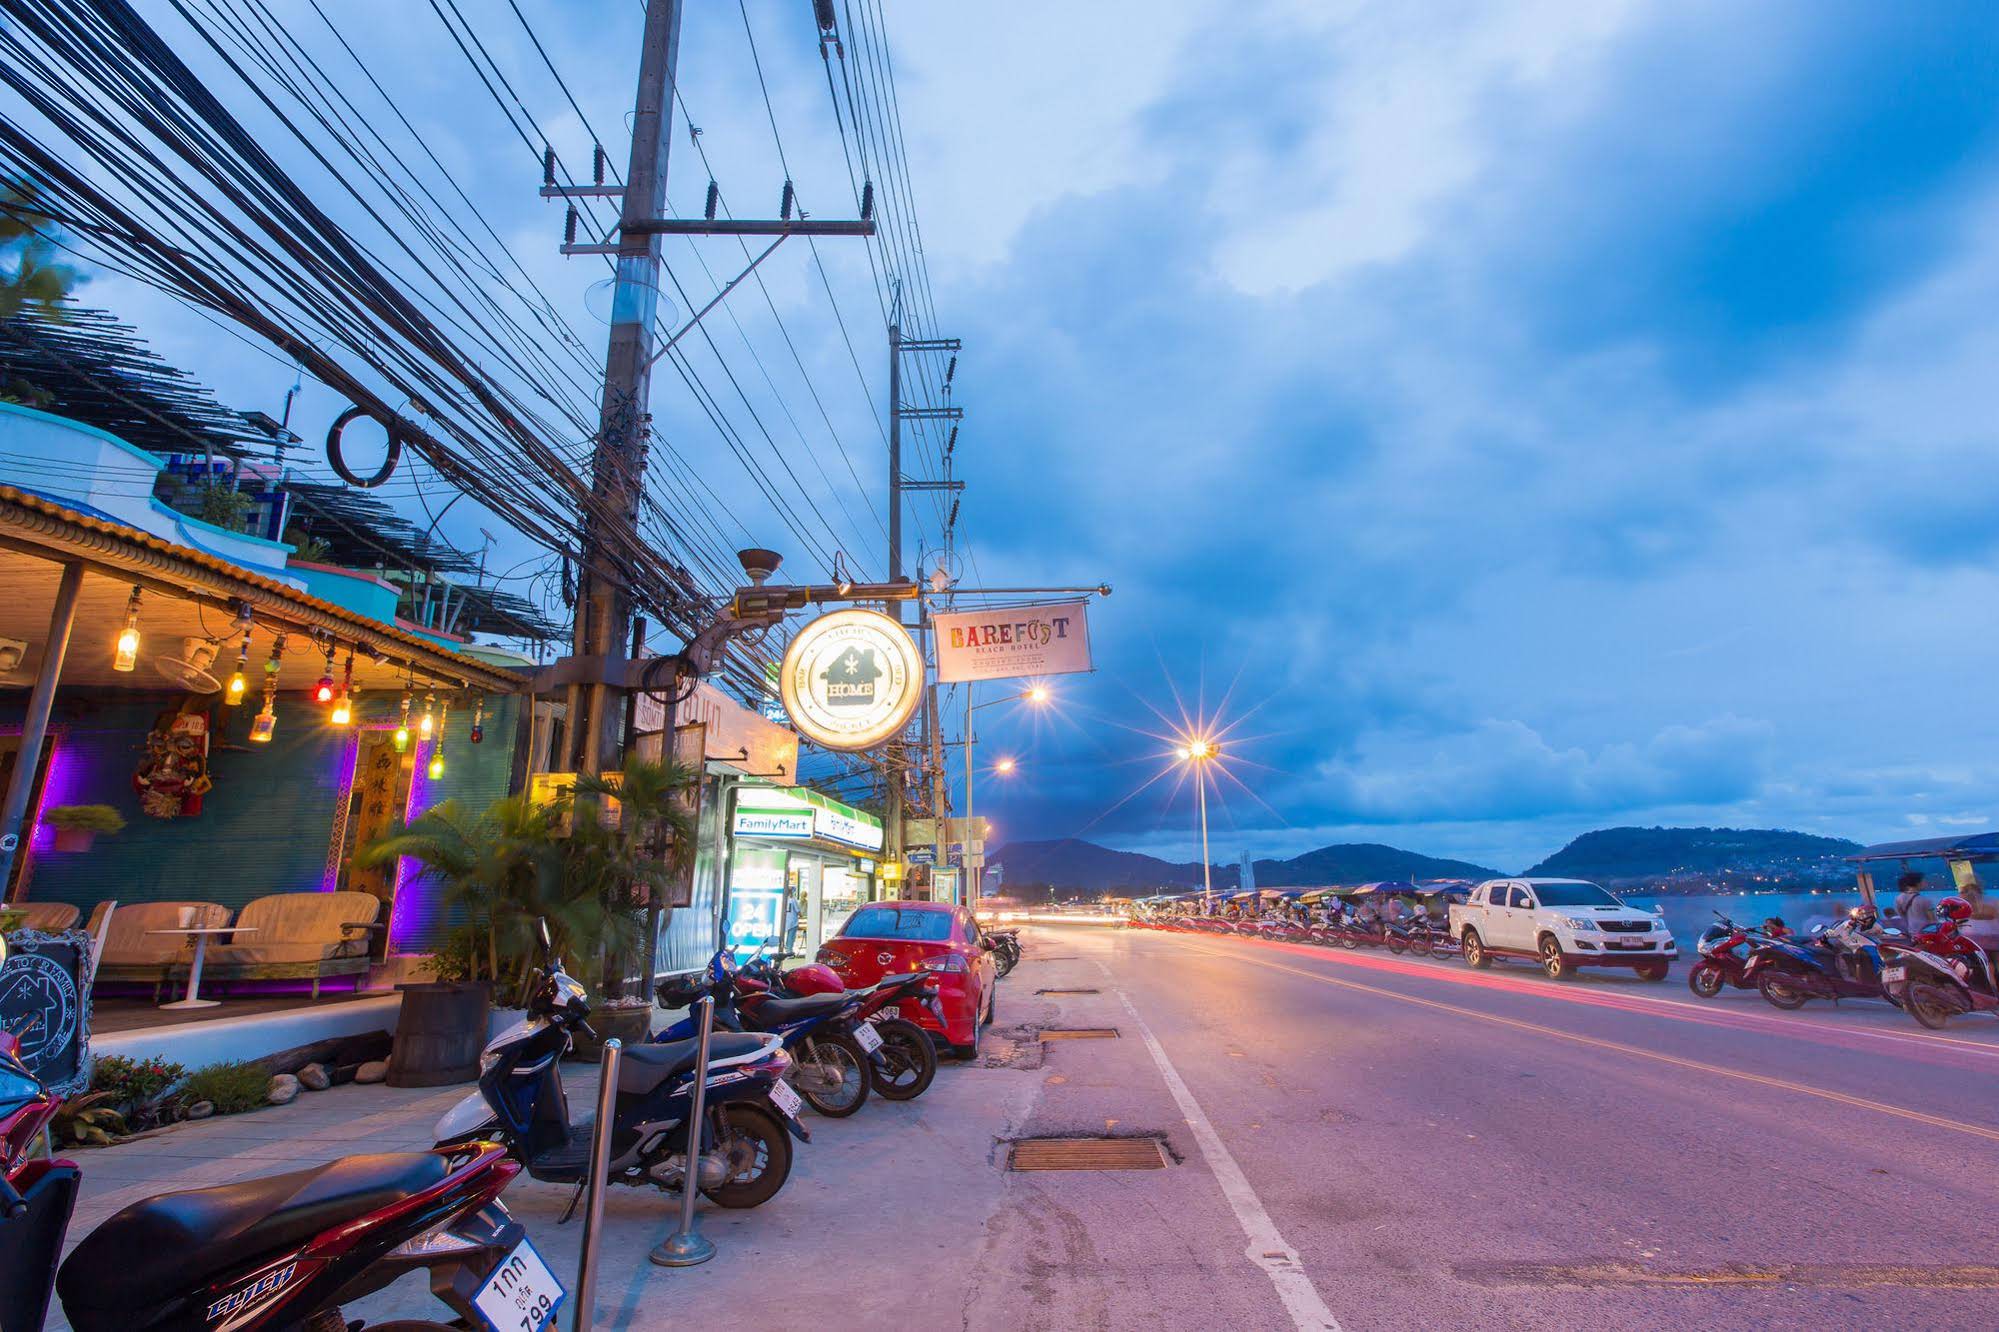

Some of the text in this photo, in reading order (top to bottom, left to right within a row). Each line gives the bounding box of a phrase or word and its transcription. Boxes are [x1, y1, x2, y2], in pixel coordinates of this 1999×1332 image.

[828, 683, 874, 697] HOME
[739, 818, 807, 830] FamilyMart
[742, 903, 766, 920] 24
[732, 922, 773, 937] OPEN
[50, 966, 73, 997] FAMILY
[493, 1256, 527, 1298] 1กก
[520, 1294, 552, 1332] 799
